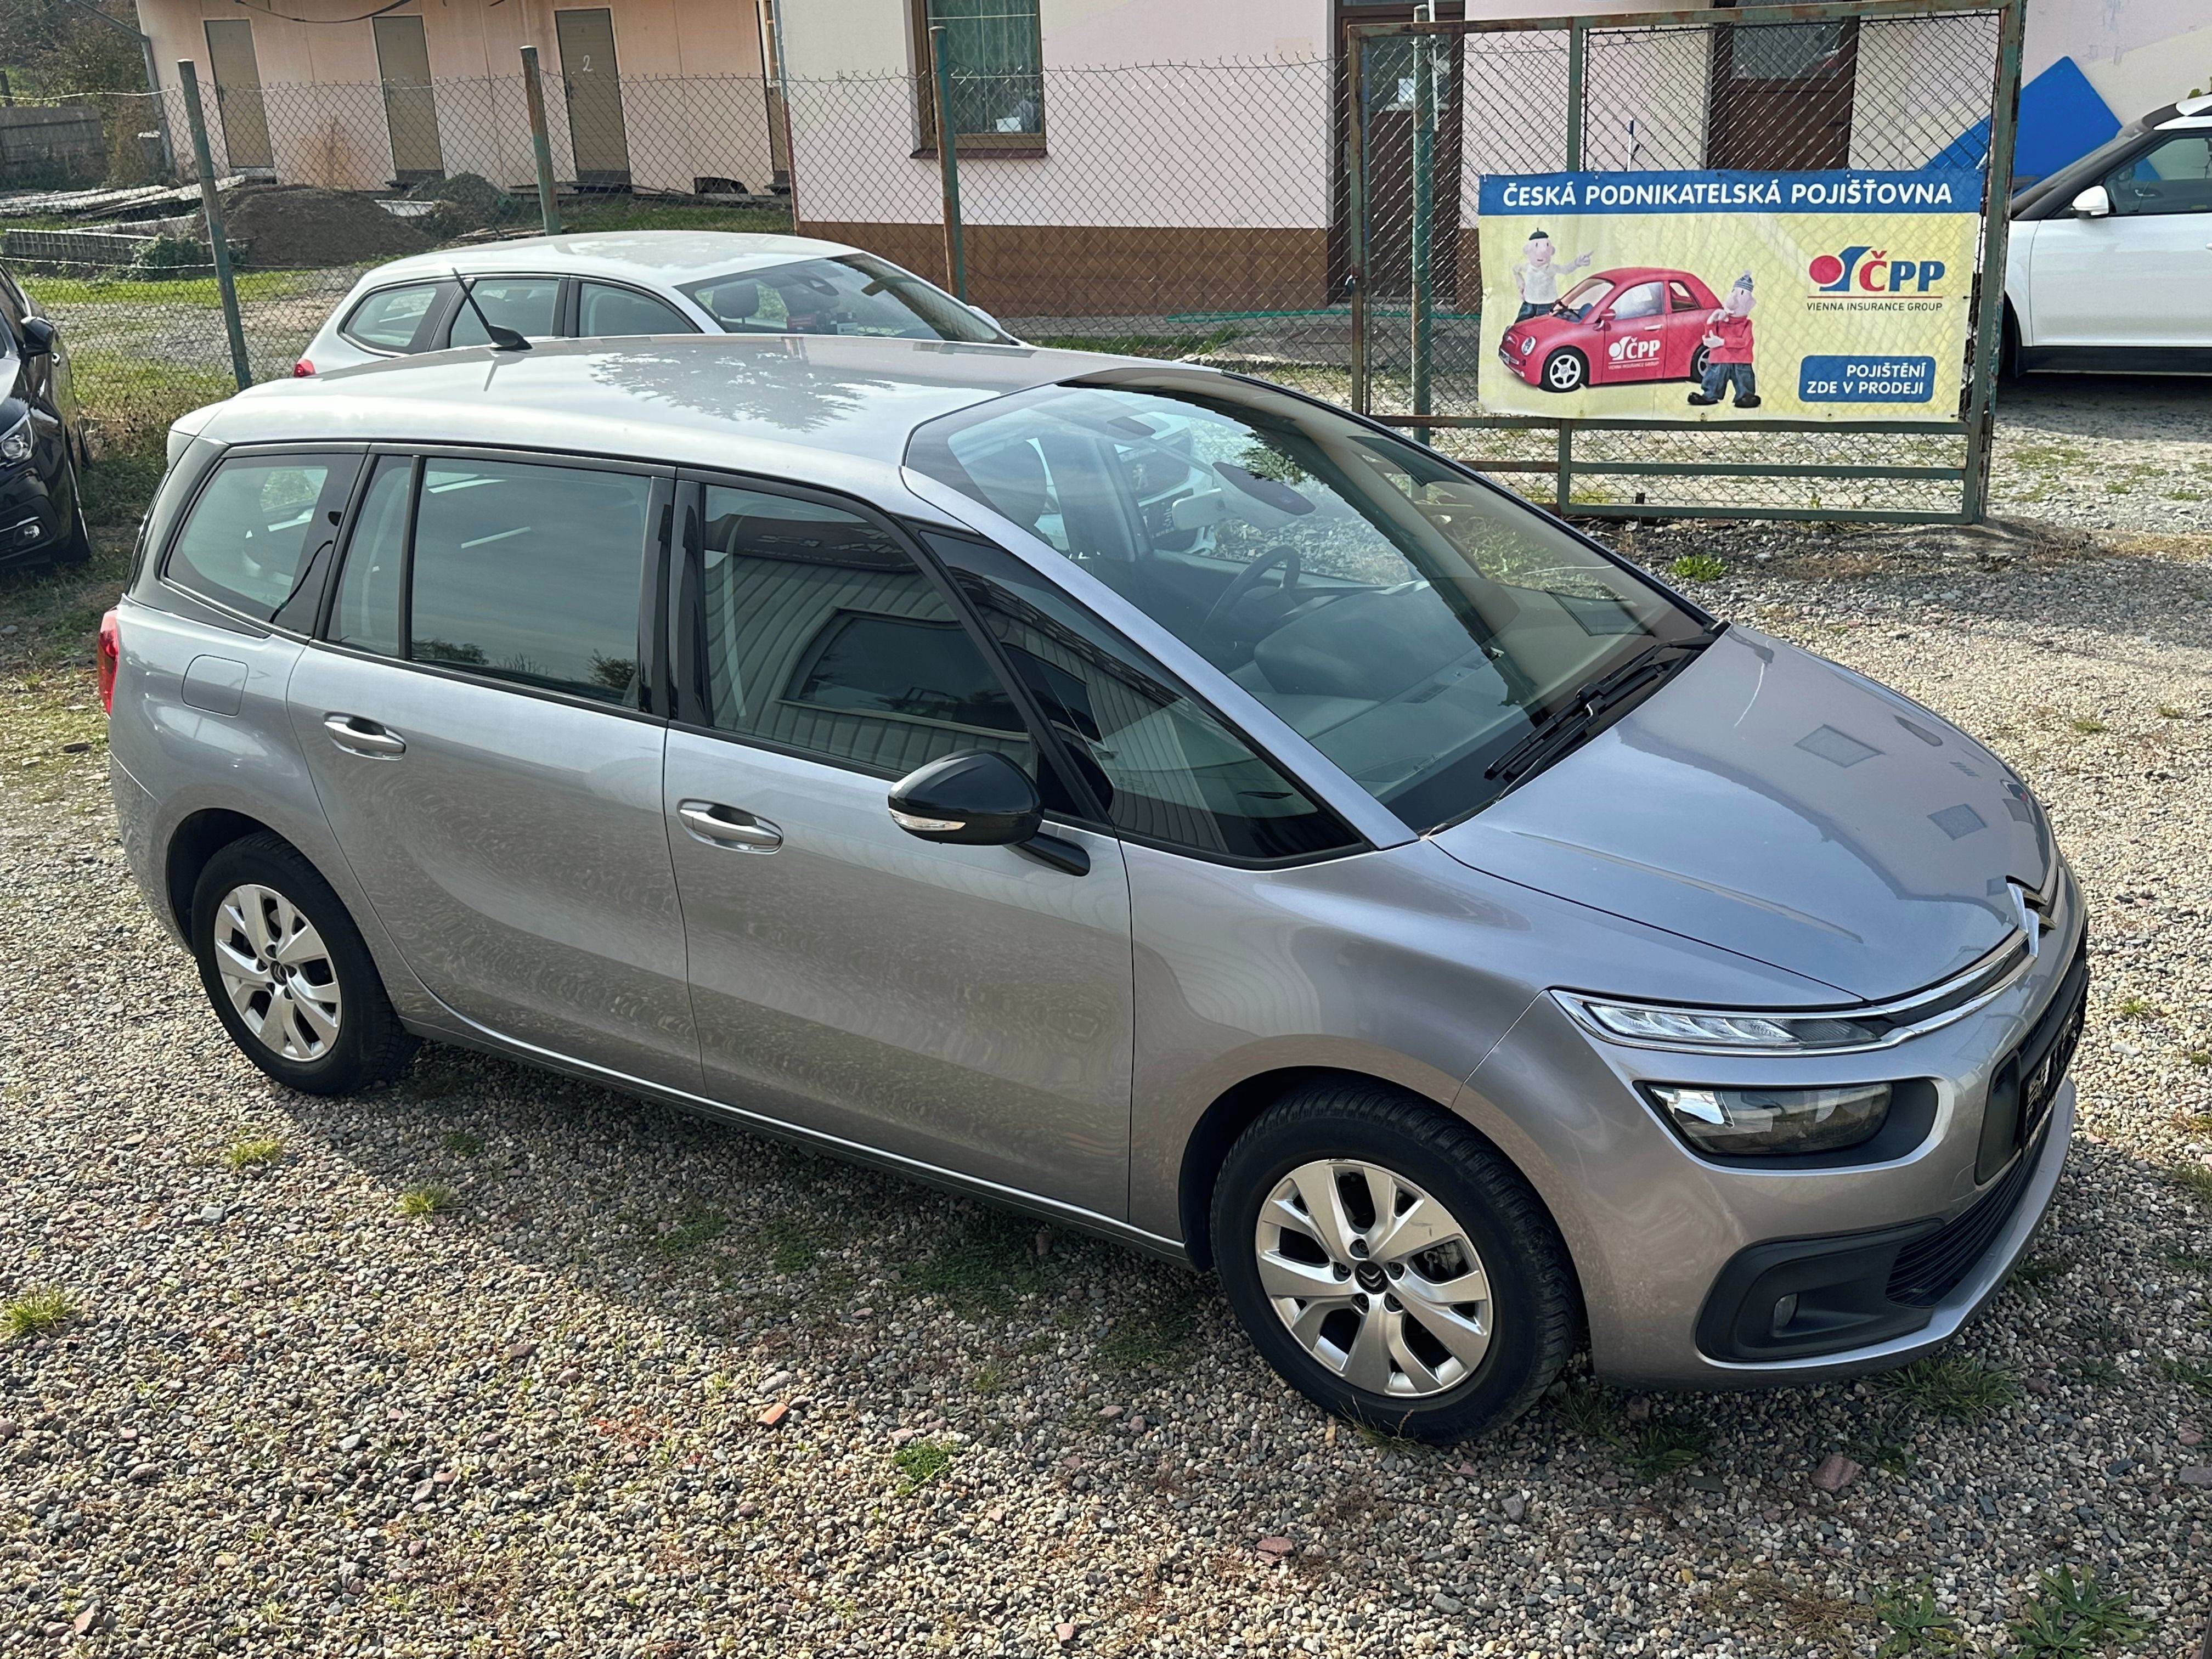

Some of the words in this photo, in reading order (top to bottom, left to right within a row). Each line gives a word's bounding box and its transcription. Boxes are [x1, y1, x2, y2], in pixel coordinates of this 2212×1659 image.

[583, 55, 594, 72] 2
[1503, 181, 1577, 206] ČESKÁ
[1585, 179, 1782, 205] PODNIKATELSKÁ
[1791, 179, 1953, 204] POJIŠŤOVNA
[1859, 250, 1945, 292] ČPP
[1807, 302, 1844, 311] VIENNA
[1847, 302, 1904, 311] INSURANCE
[1908, 302, 1943, 311] GROUP
[1626, 337, 1661, 359] ČPP
[1847, 362, 1927, 377] POJIŠTĚNÍ
[1806, 381, 1838, 394] ZDE
[1843, 381, 1854, 394] V
[1858, 381, 1923, 394] PRODEJI
